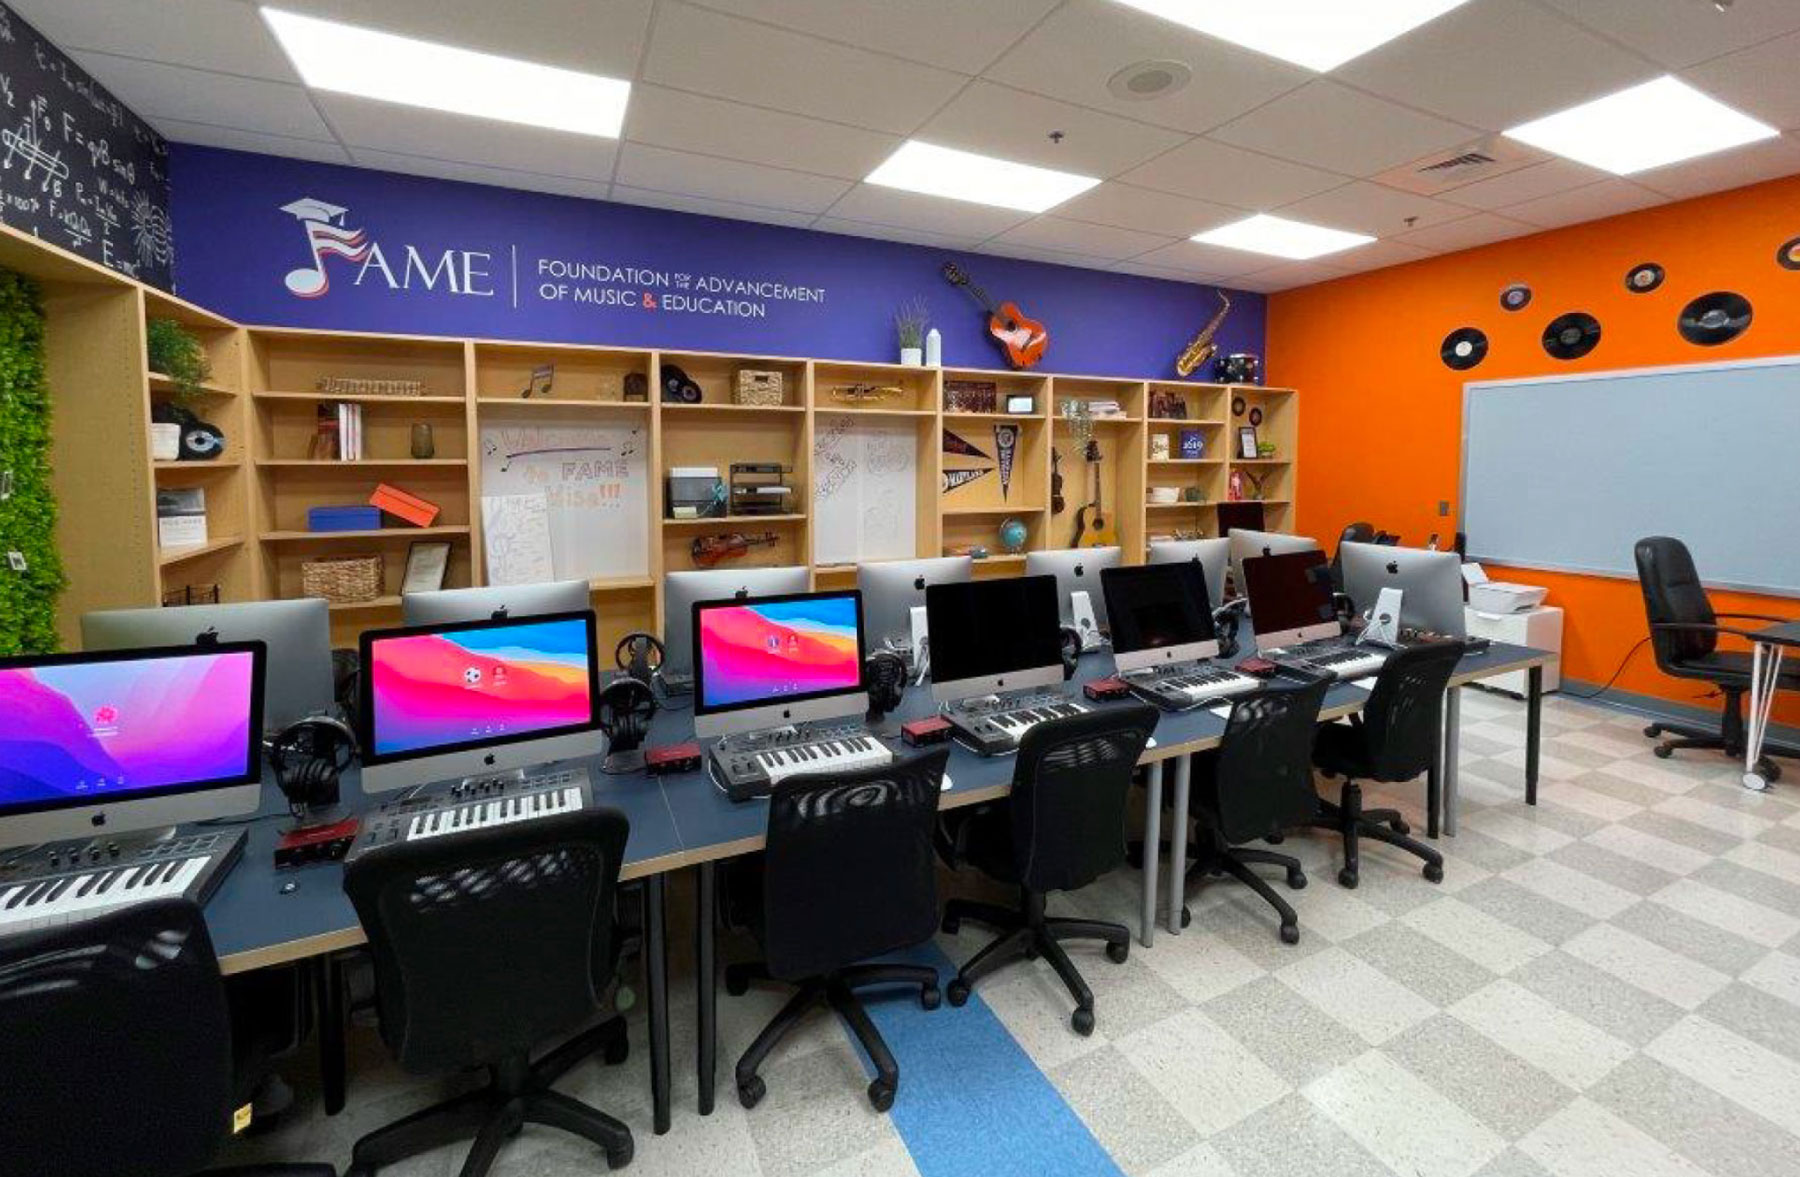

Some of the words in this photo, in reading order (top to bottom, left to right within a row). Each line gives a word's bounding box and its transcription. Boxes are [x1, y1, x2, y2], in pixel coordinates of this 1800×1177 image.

[537, 258, 669, 288] FOUNDATION
[674, 272, 692, 282] FOR
[695, 276, 826, 304] ADVANCEMENT
[539, 283, 568, 301] OF
[574, 288, 637, 307] MUSIC
[642, 291, 657, 309] &
[661, 294, 766, 319] EDUCATION
[561, 459, 630, 482] FAME
